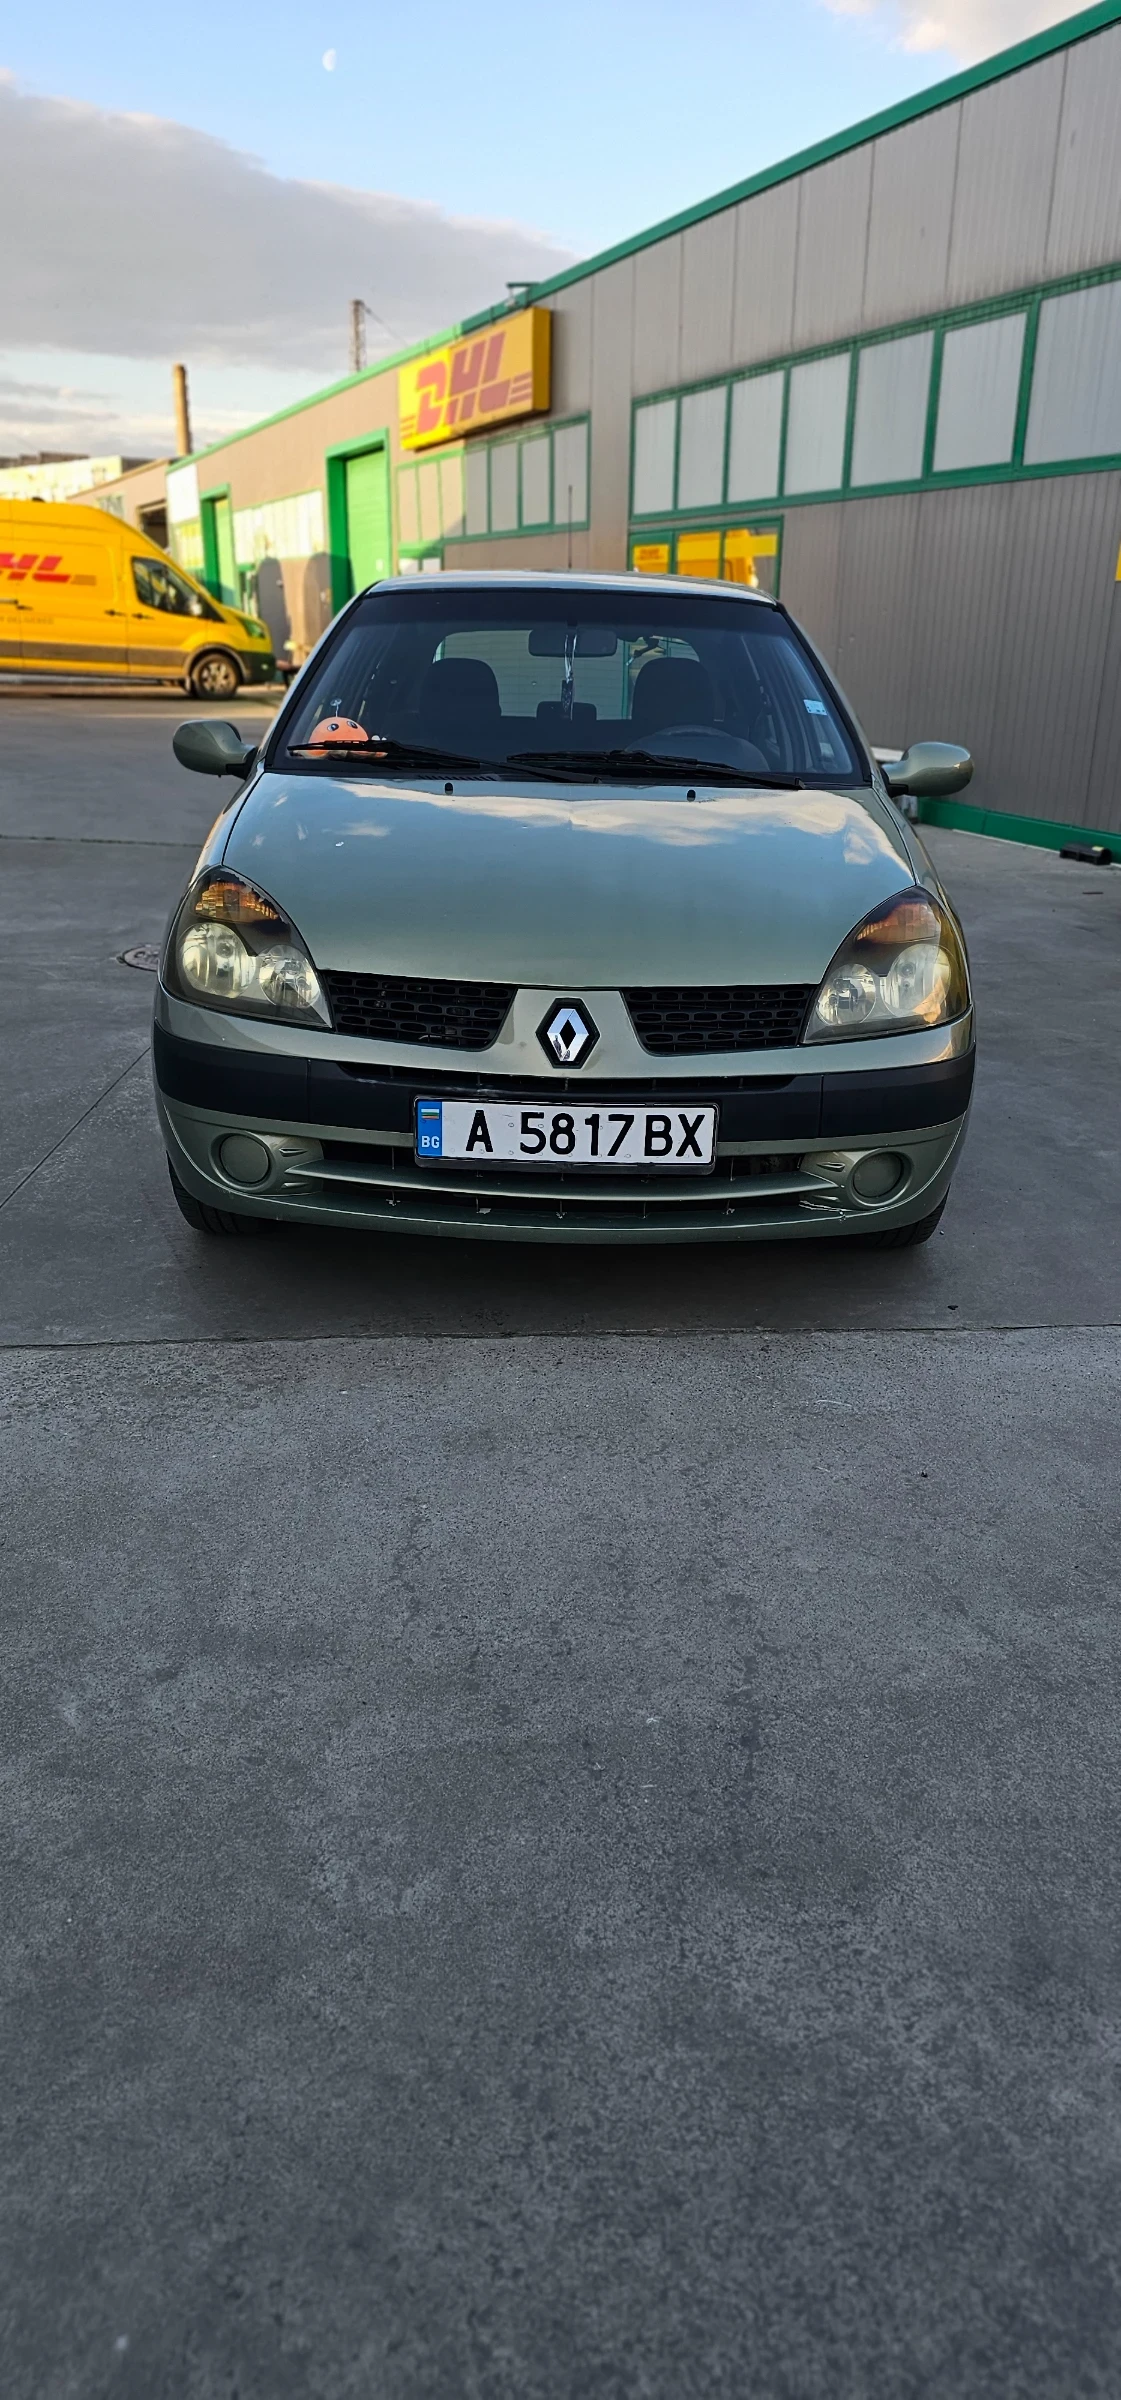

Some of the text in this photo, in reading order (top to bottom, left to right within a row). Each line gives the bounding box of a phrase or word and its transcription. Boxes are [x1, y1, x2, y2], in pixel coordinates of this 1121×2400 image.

[416, 331, 511, 435] DHL
[0, 553, 70, 584] HL
[421, 1135, 440, 1149] BG
[465, 1109, 706, 1158] A 5817 BX
